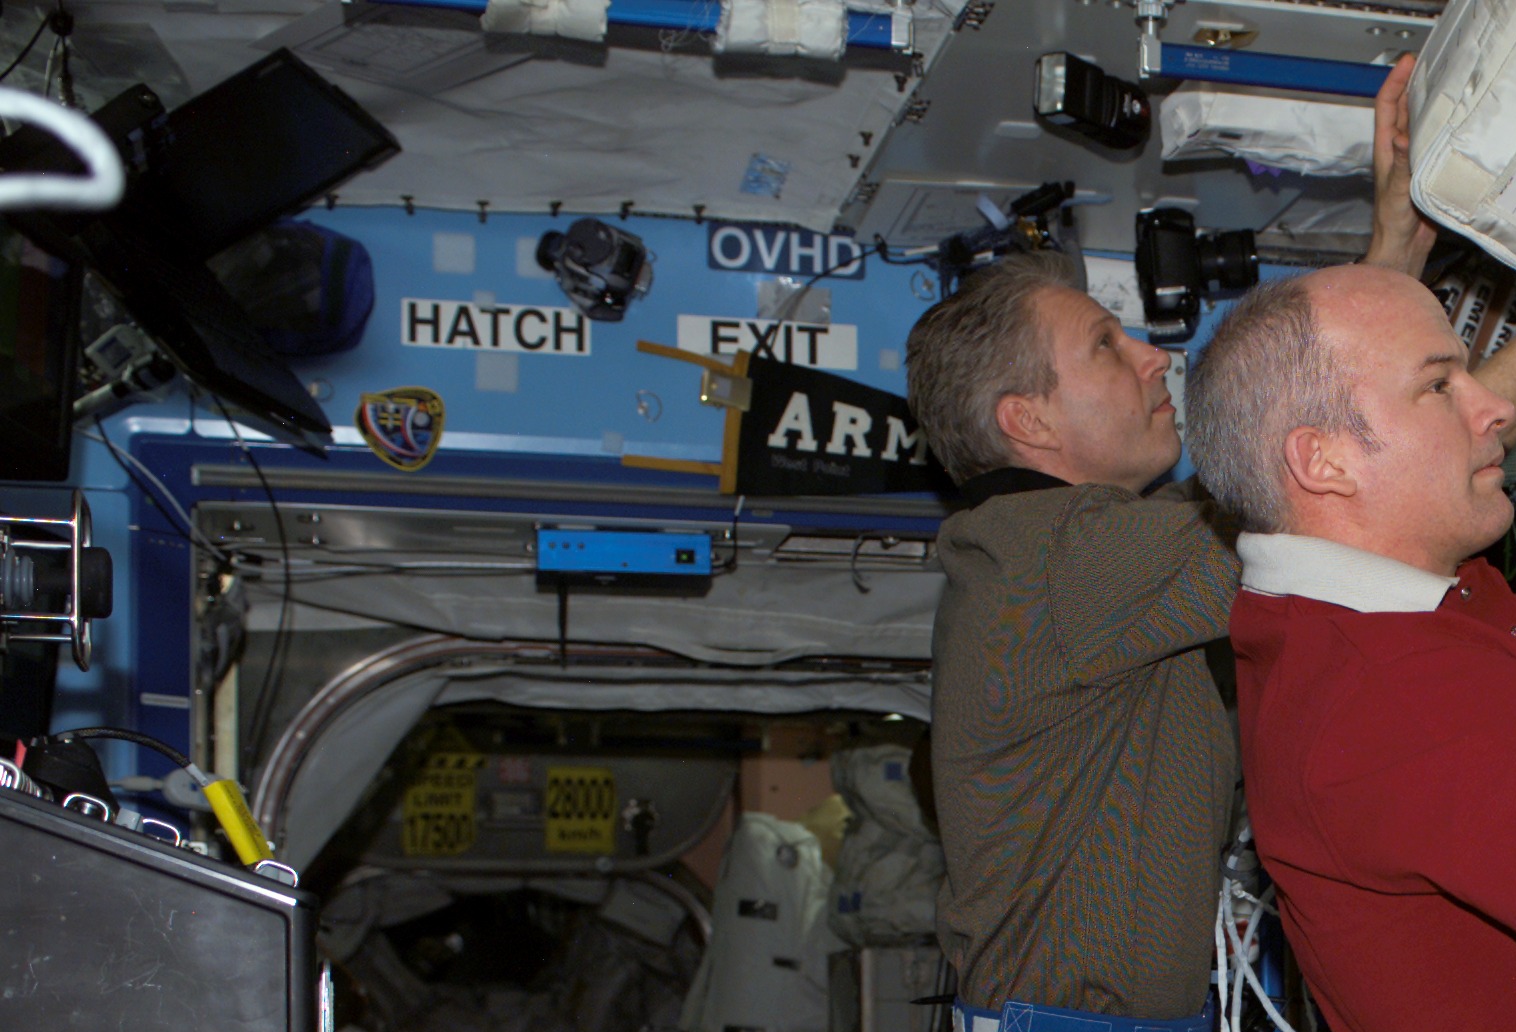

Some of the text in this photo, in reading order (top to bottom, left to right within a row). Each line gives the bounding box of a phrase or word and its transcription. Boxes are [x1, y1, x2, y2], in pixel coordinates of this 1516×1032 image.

[711, 226, 861, 275] OVHD
[408, 302, 586, 353] HATCH
[711, 319, 829, 366] EXIT
